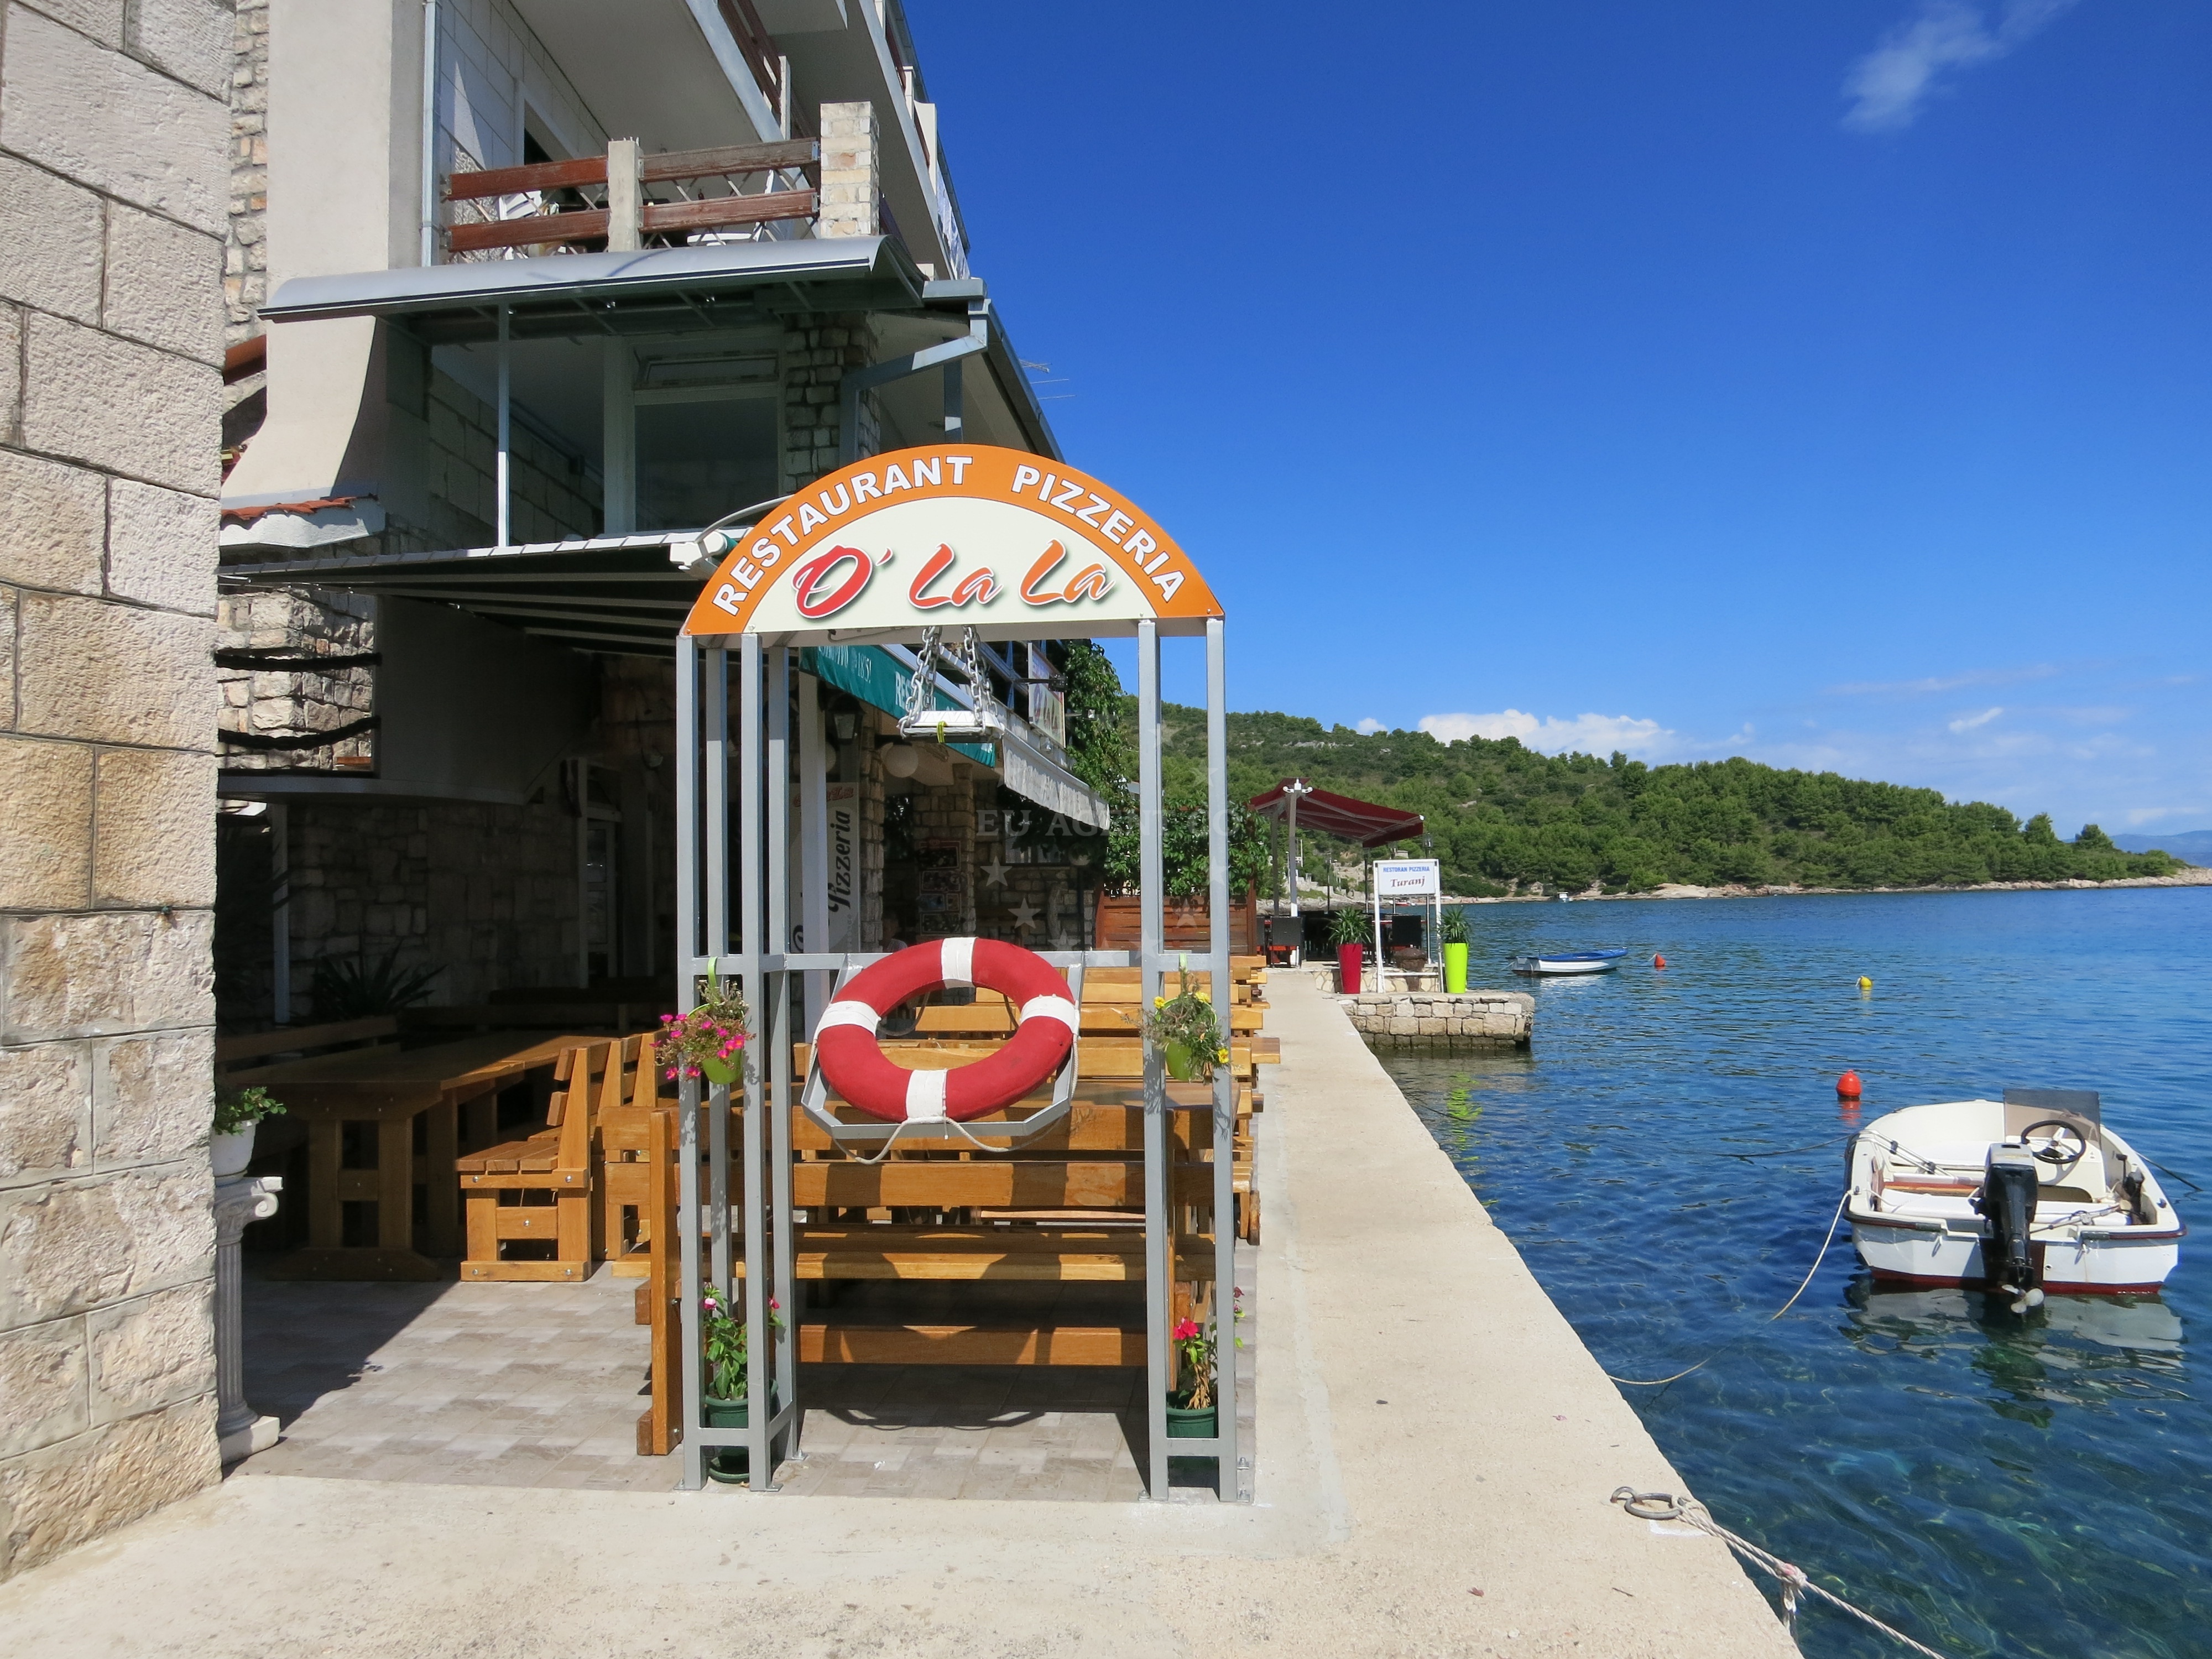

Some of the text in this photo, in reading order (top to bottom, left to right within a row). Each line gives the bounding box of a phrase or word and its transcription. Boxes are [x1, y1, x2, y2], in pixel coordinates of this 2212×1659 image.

[712, 455, 1186, 617] RESTAURANT PIZZERIA
[907, 541, 1004, 609] La
[1019, 538, 1116, 606] La
[1390, 875, 1426, 888] Turanj
